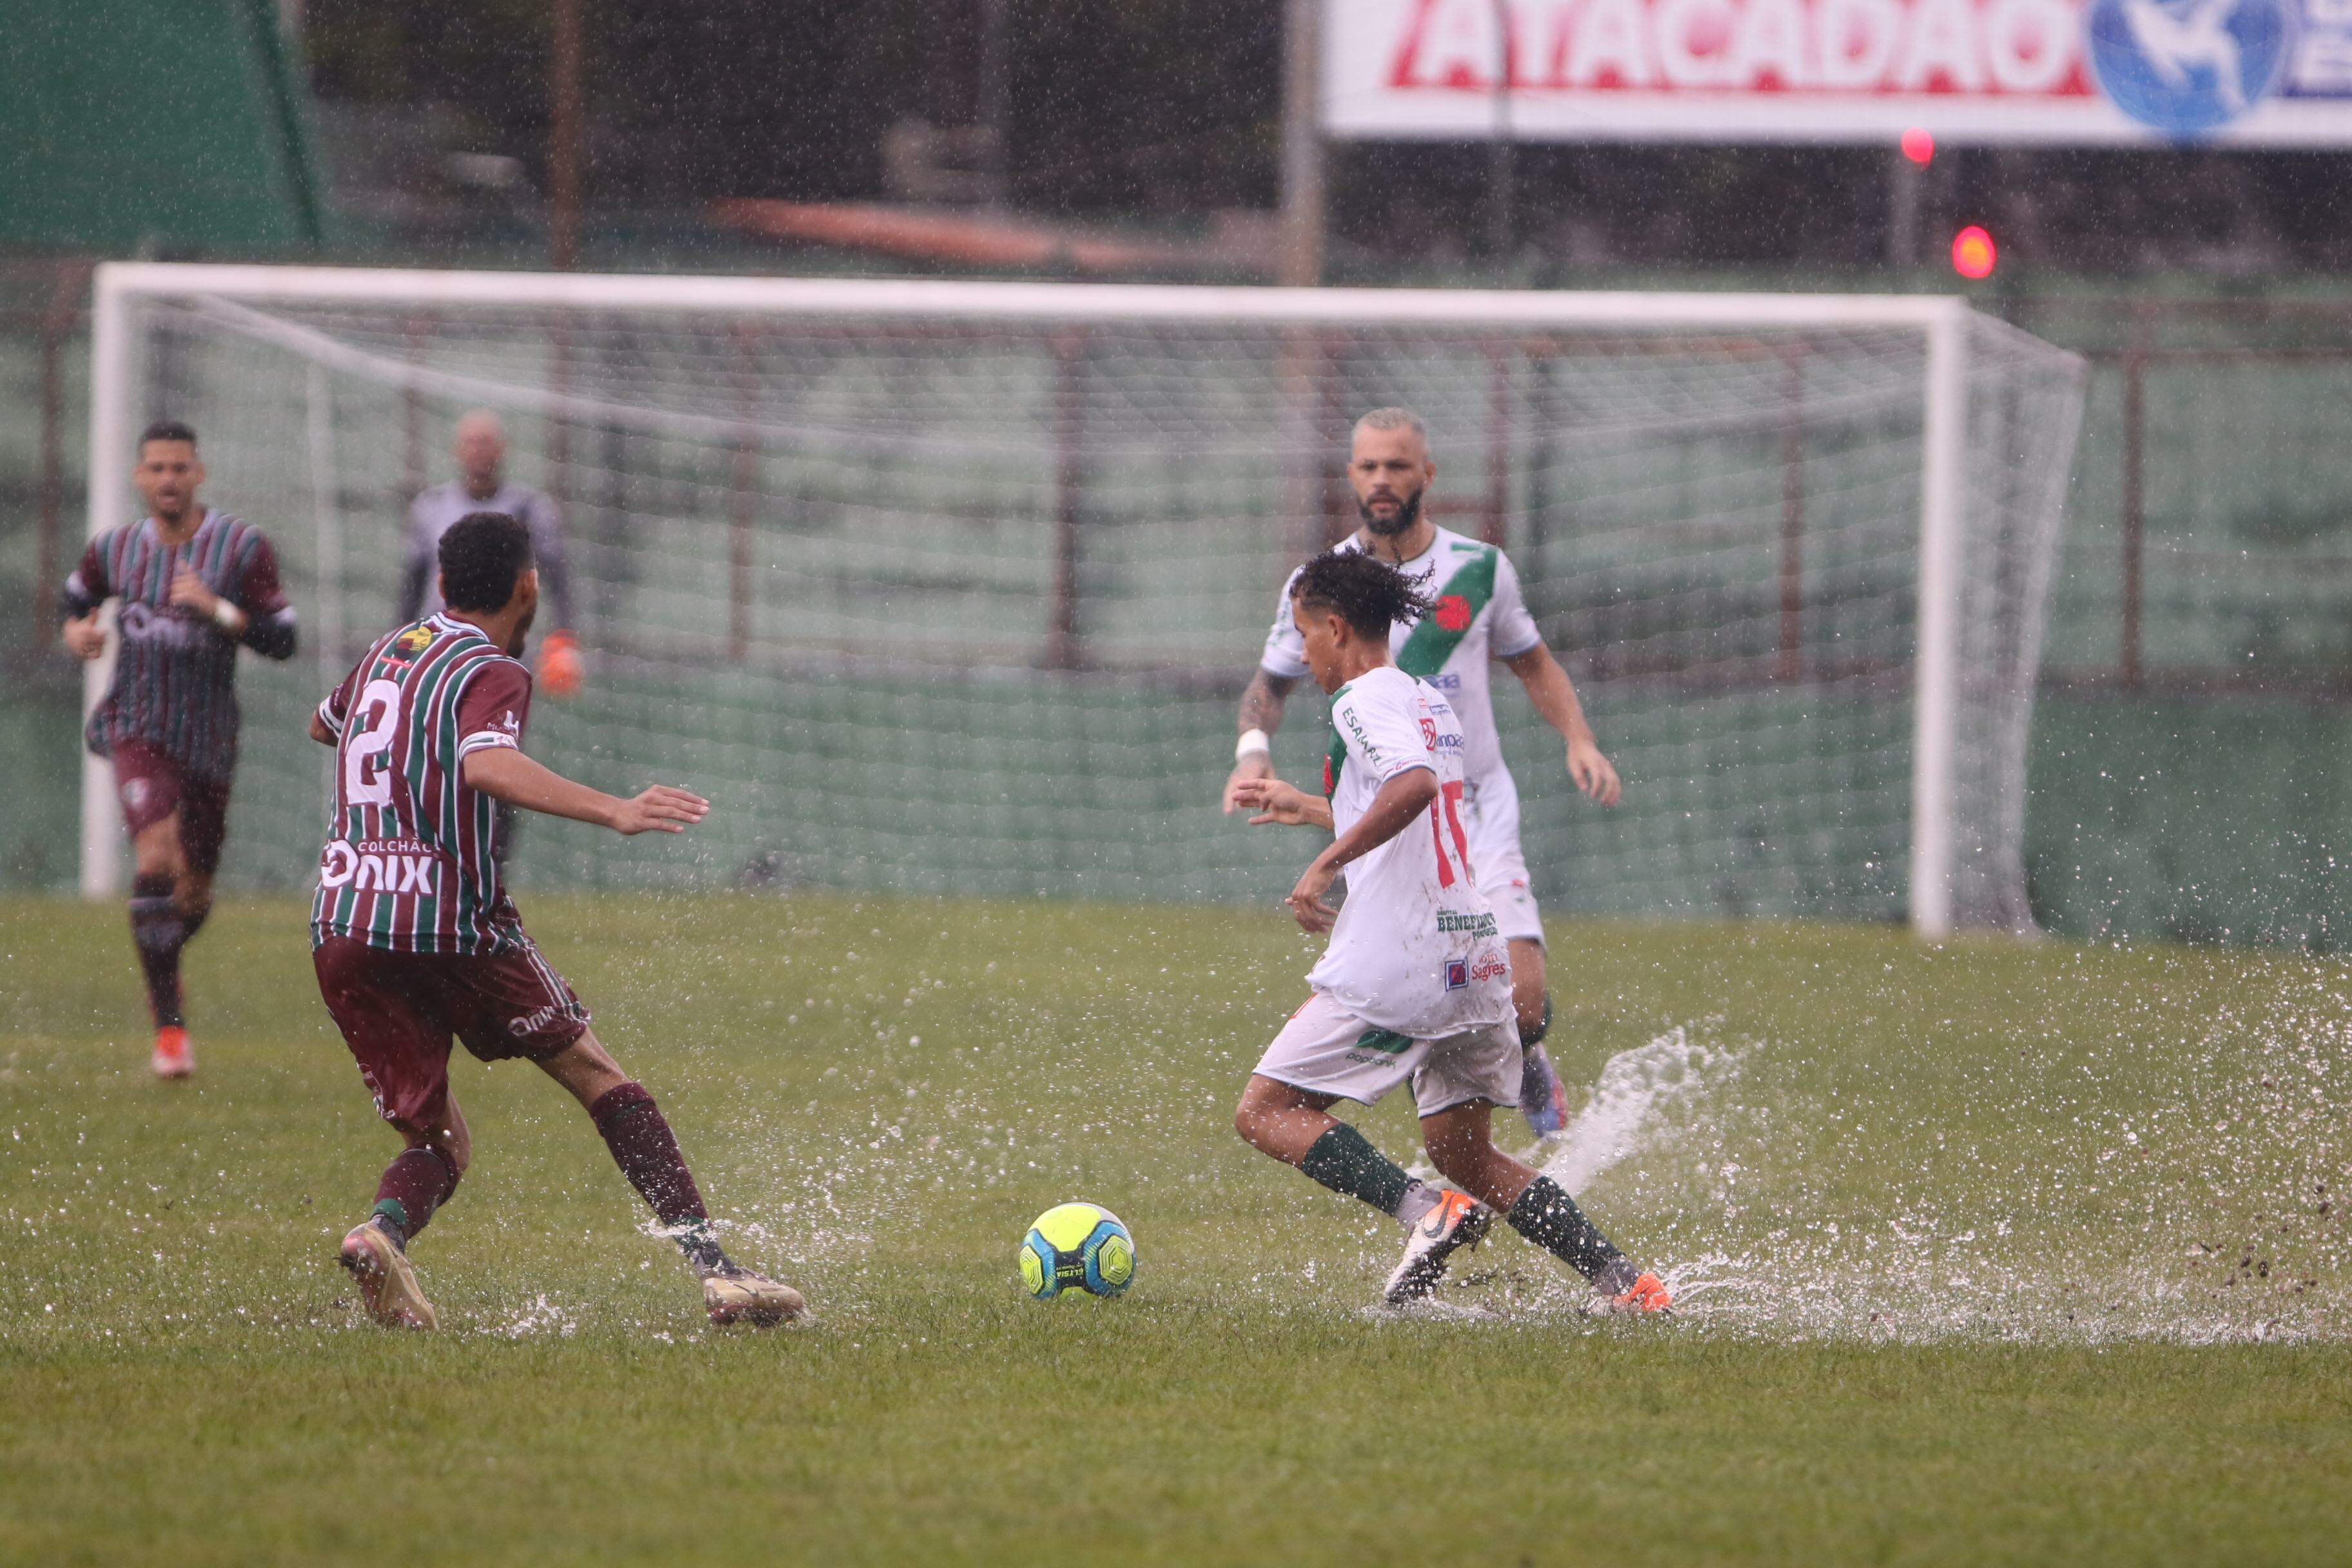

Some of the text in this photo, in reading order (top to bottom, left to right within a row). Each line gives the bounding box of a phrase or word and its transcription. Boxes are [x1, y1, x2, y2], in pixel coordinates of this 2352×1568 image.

[346, 678, 400, 807] 2
[1471, 963, 1506, 981] Sagres
[1346, 1053, 1396, 1070] popbank
